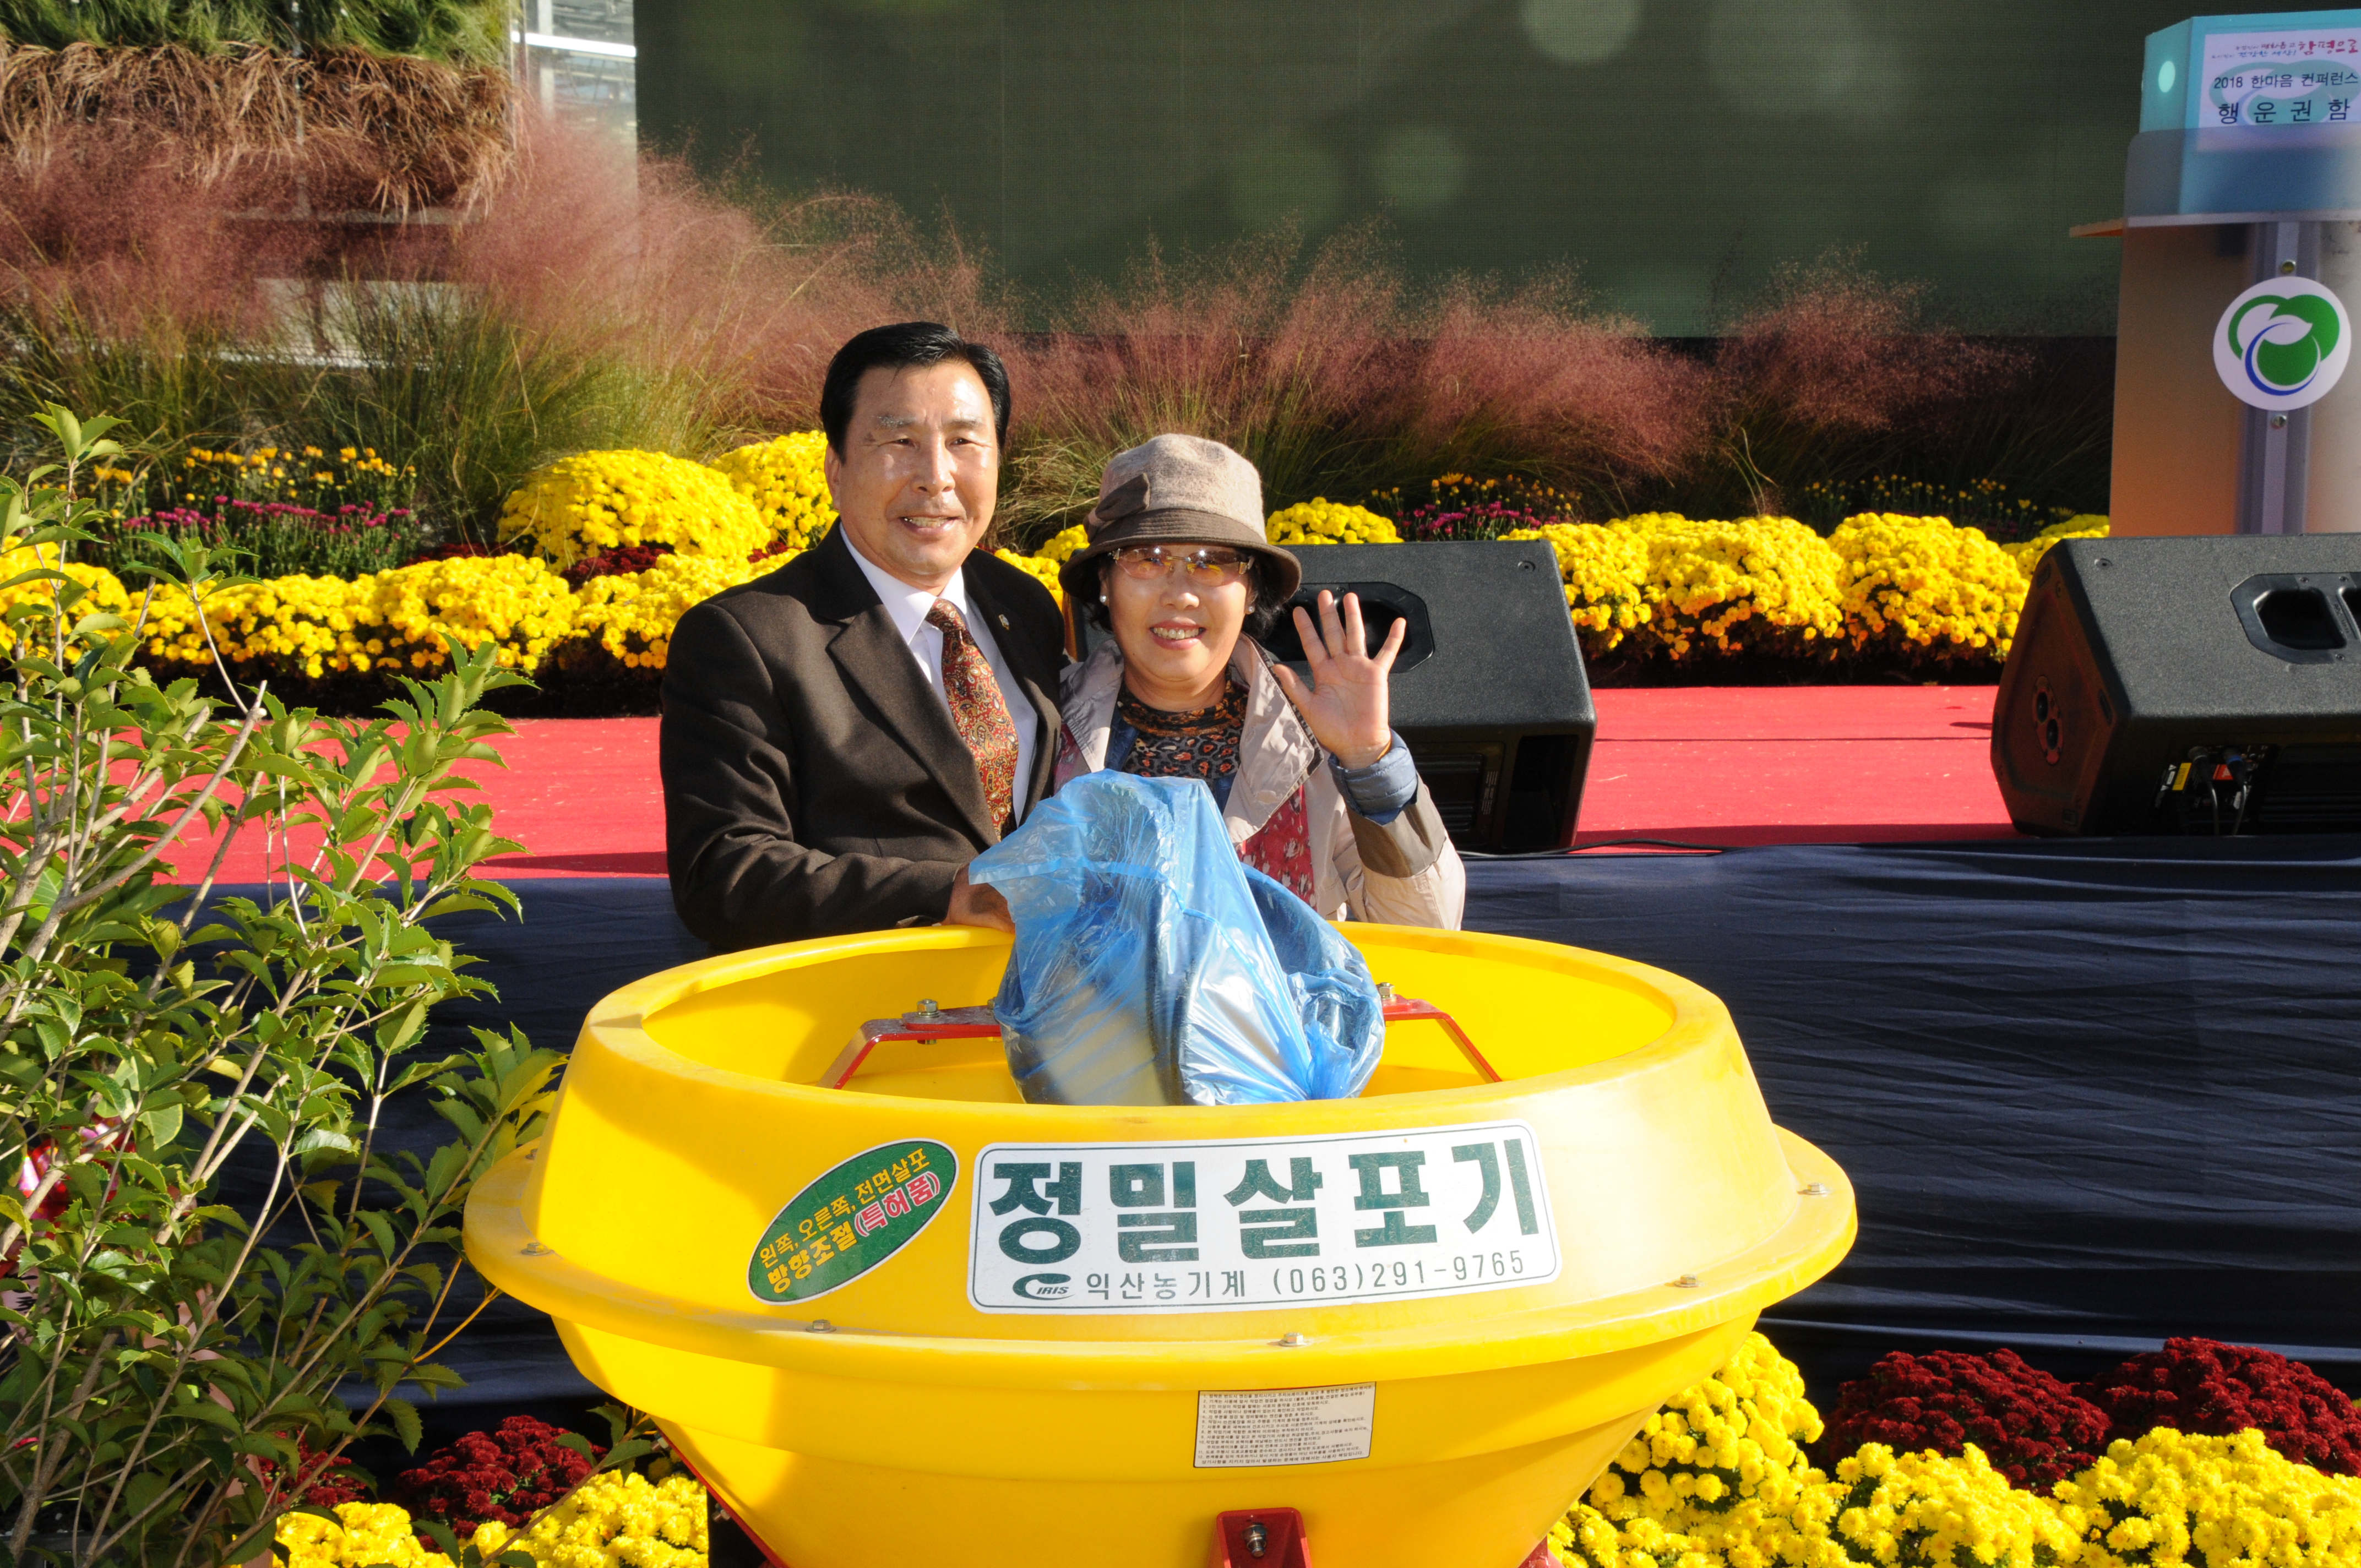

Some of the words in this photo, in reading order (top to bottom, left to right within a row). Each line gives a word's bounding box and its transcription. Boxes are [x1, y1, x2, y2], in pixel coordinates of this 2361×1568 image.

[2213, 76, 2243, 89] 2018
[2250, 74, 2293, 89] 한마음
[2301, 71, 2359, 87] 컨퍼런스
[759, 1232, 799, 1269] 왼쪽,
[798, 1195, 856, 1243] 오른쪽,
[853, 1147, 931, 1205] 전면살포
[988, 1137, 1539, 1265] 정밀살포기
[1086, 1270, 1245, 1301] 익산농기계
[1273, 1249, 1524, 1295] (063)291-9765
